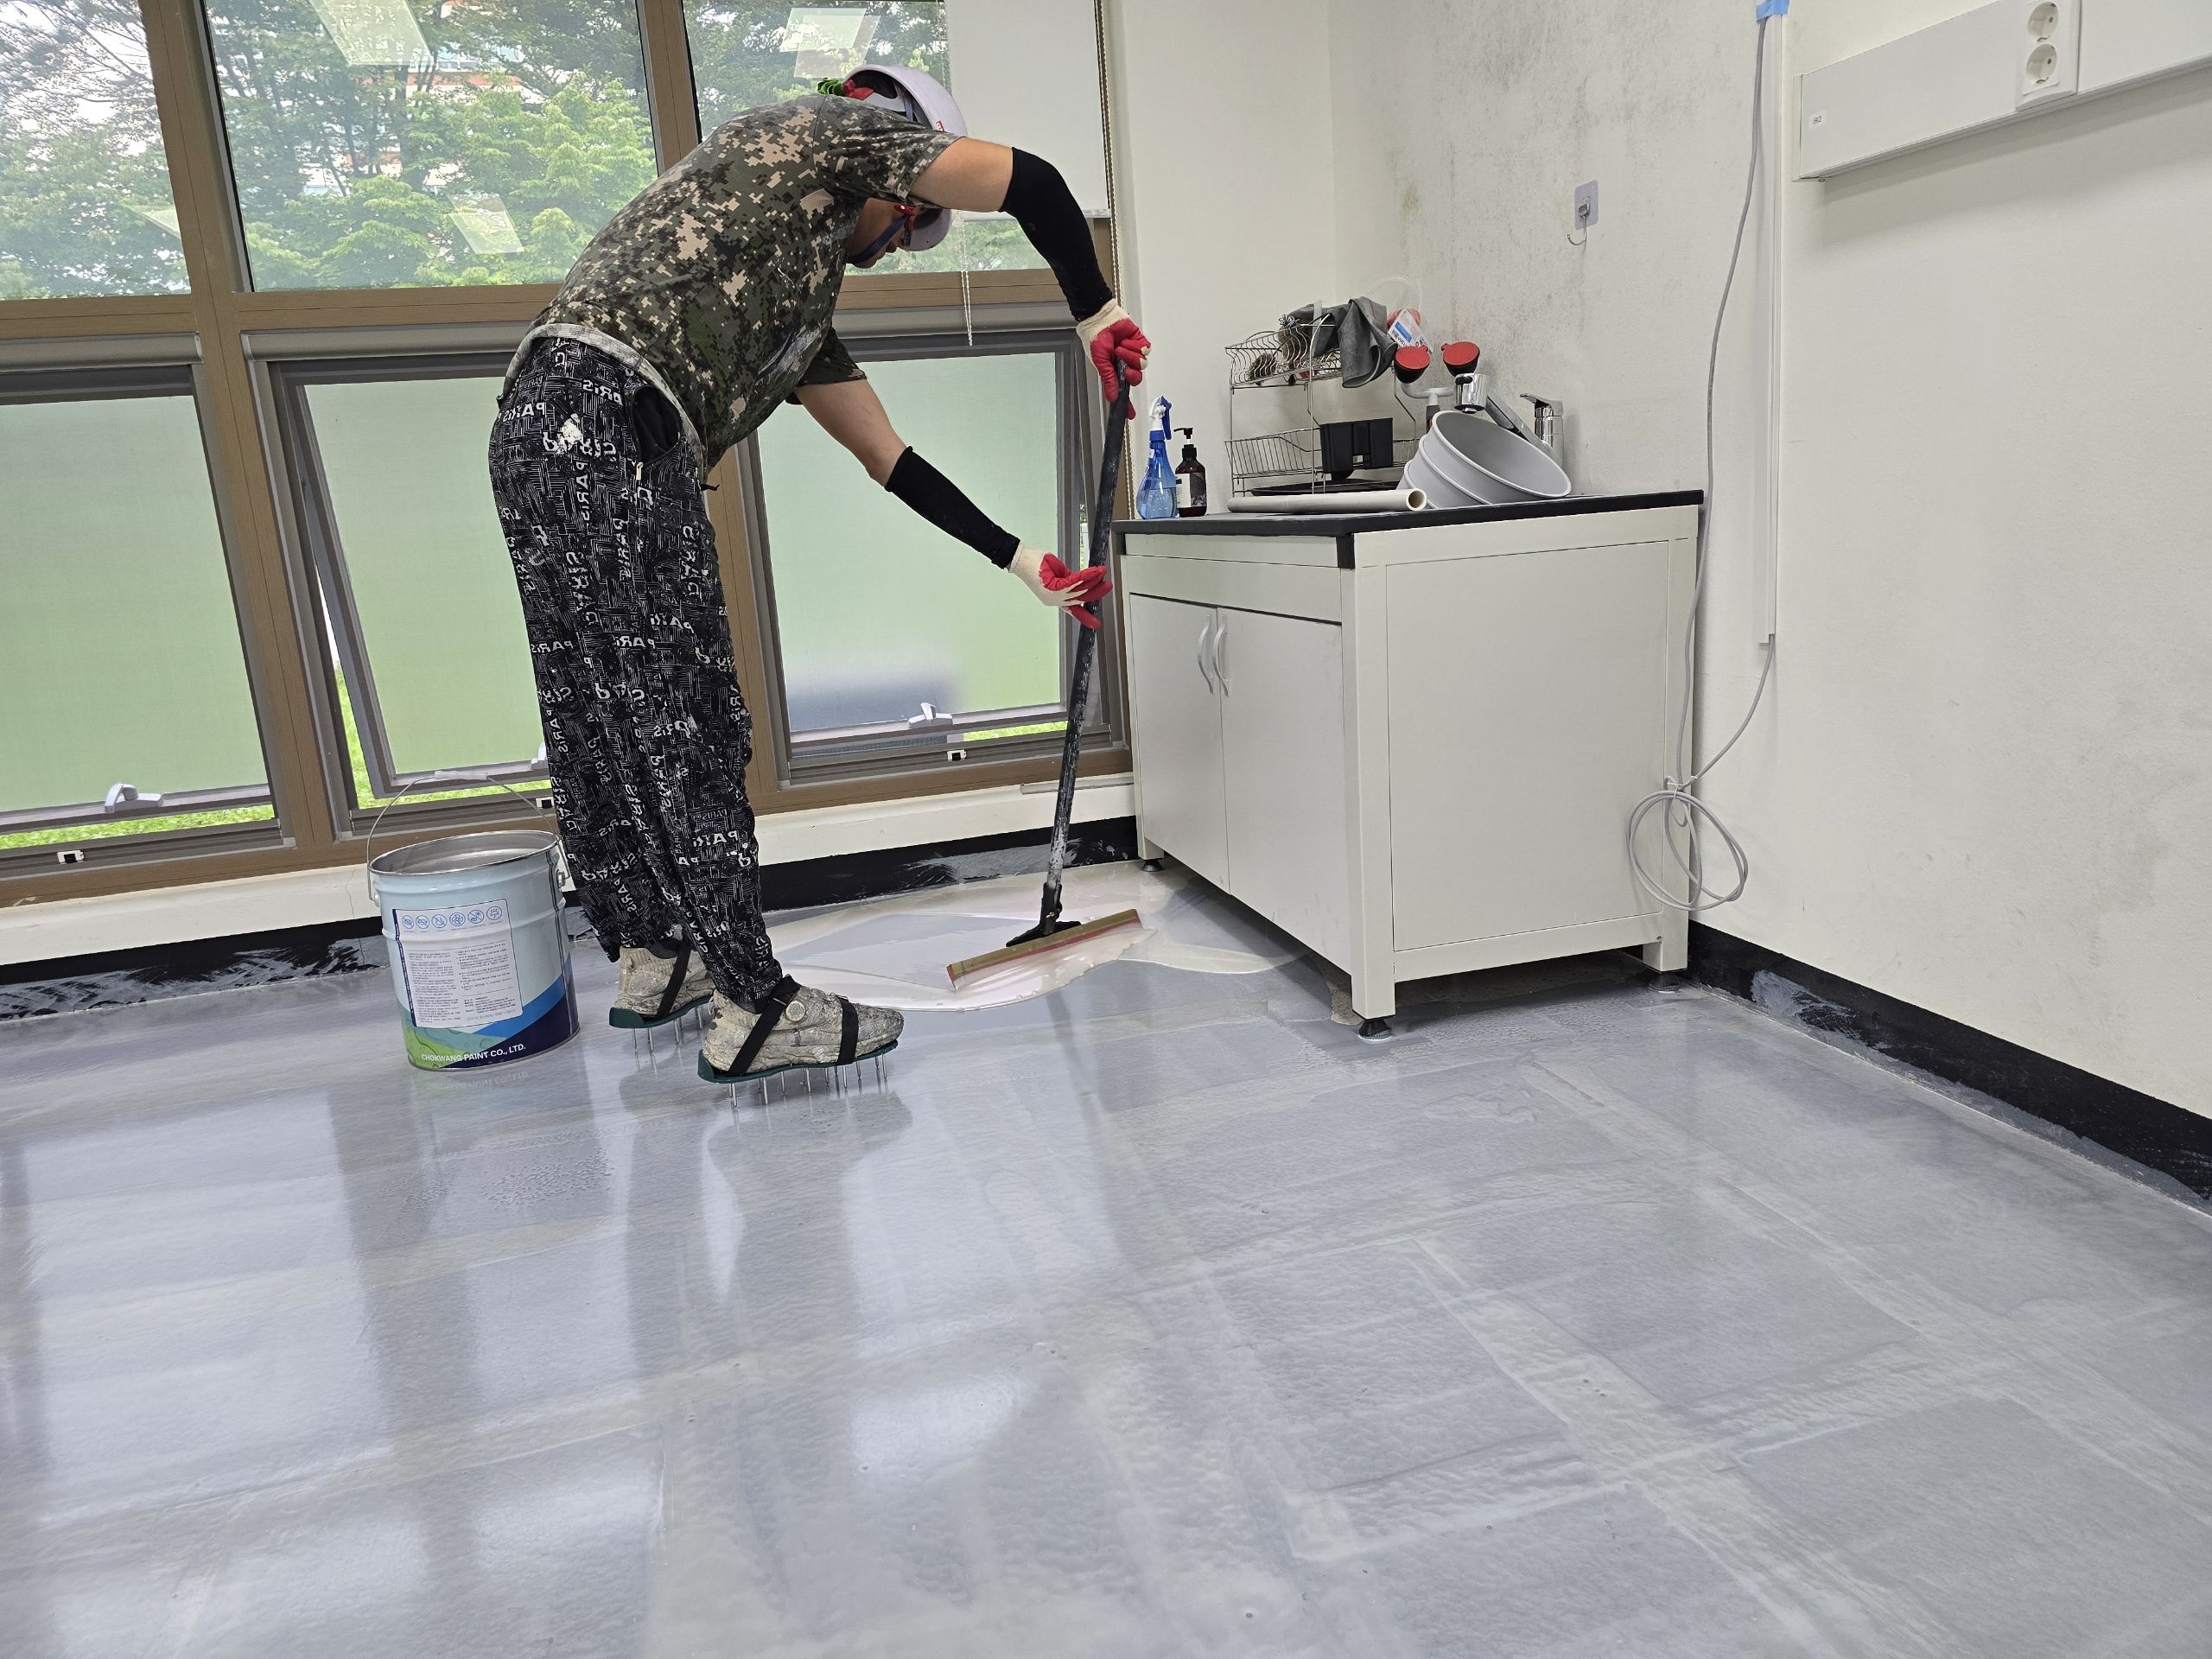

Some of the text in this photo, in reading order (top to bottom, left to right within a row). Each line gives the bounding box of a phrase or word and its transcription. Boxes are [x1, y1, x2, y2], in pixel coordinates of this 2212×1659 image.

[421, 1053, 462, 1062] CHOKWANG
[464, 1052, 489, 1061] PAINT
[509, 1043, 526, 1053] LTD.
